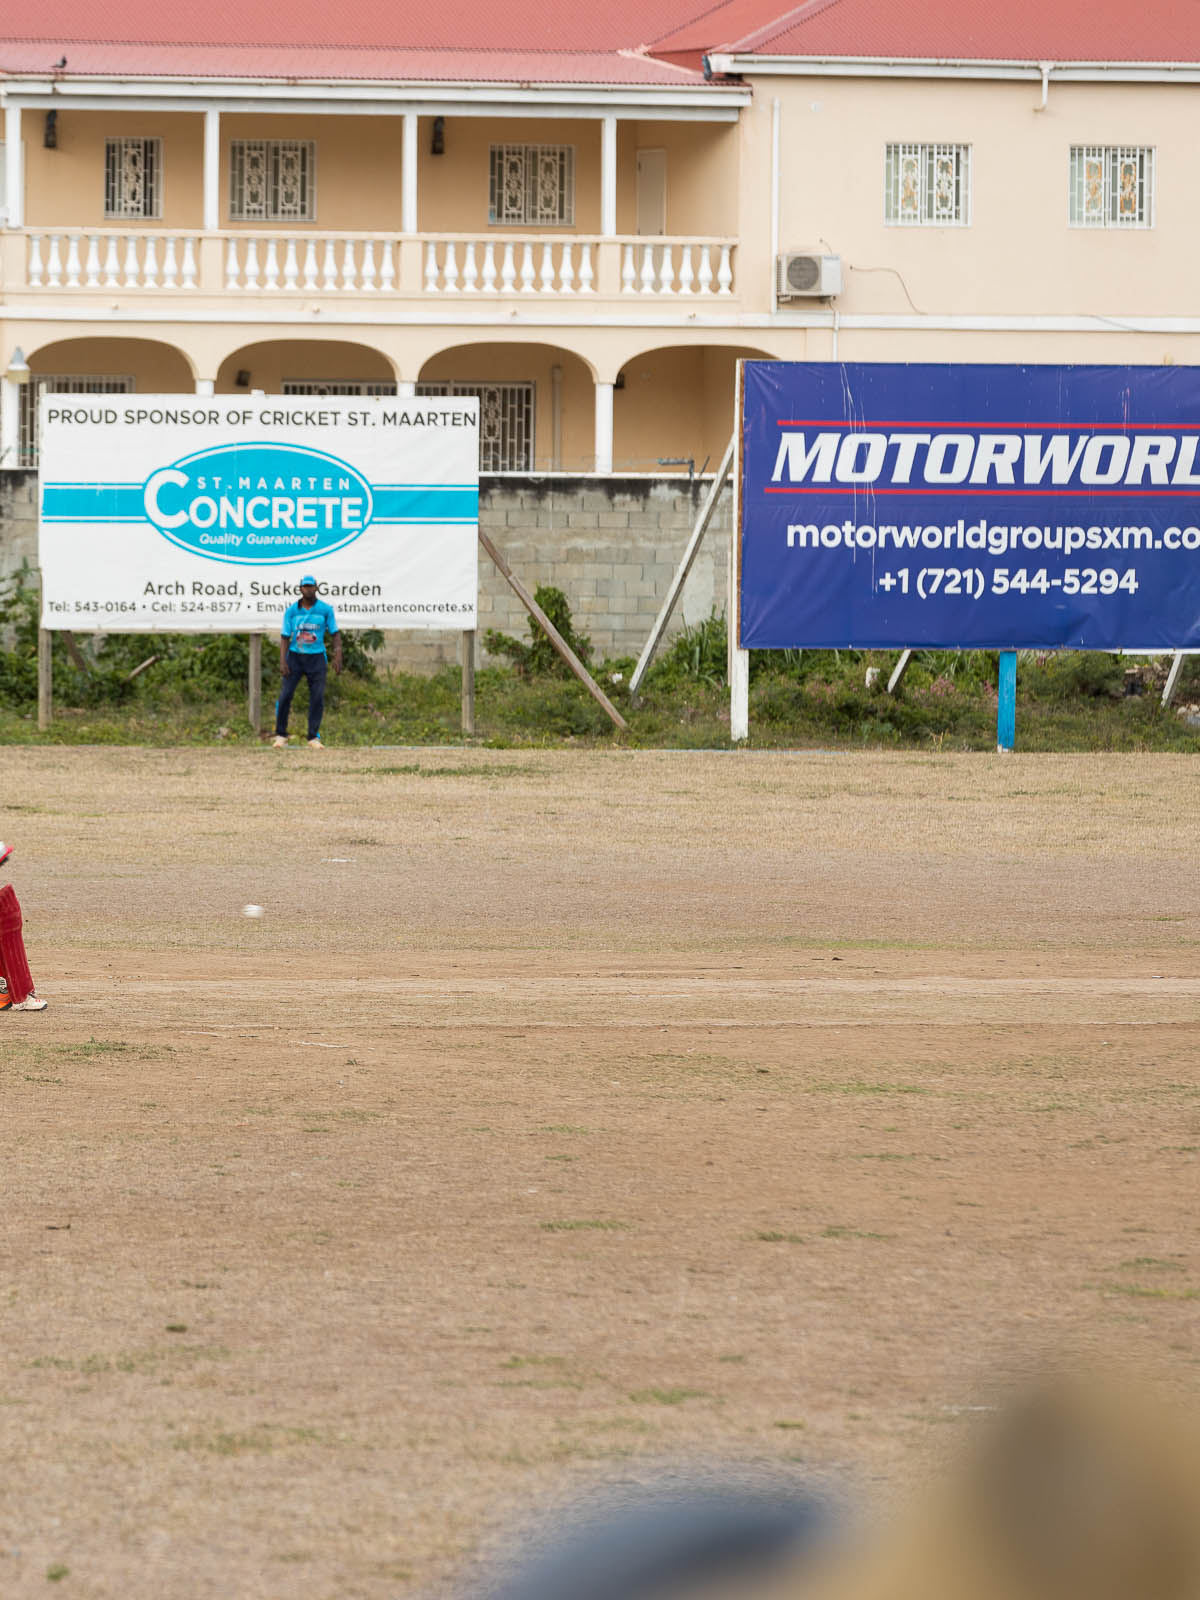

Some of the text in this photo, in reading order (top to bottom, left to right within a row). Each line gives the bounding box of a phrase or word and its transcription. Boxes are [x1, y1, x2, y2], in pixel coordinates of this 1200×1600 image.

[48, 410, 476, 427] PROUD SPONSOR OF CRICKET ST. MAARTEN
[144, 469, 364, 529] CONCRETE
[199, 533, 317, 546] Quality Guaranteed
[787, 520, 1200, 554] motorworldgroupsxm.co
[144, 581, 381, 597] Arch Road, Sucke Garden
[879, 568, 1138, 600] +1 (721) 544-5294
[49, 601, 70, 612] Tel:
[75, 601, 137, 612] 543-0164
[151, 602, 176, 612] Cel:
[180, 602, 241, 612] 524-8577
